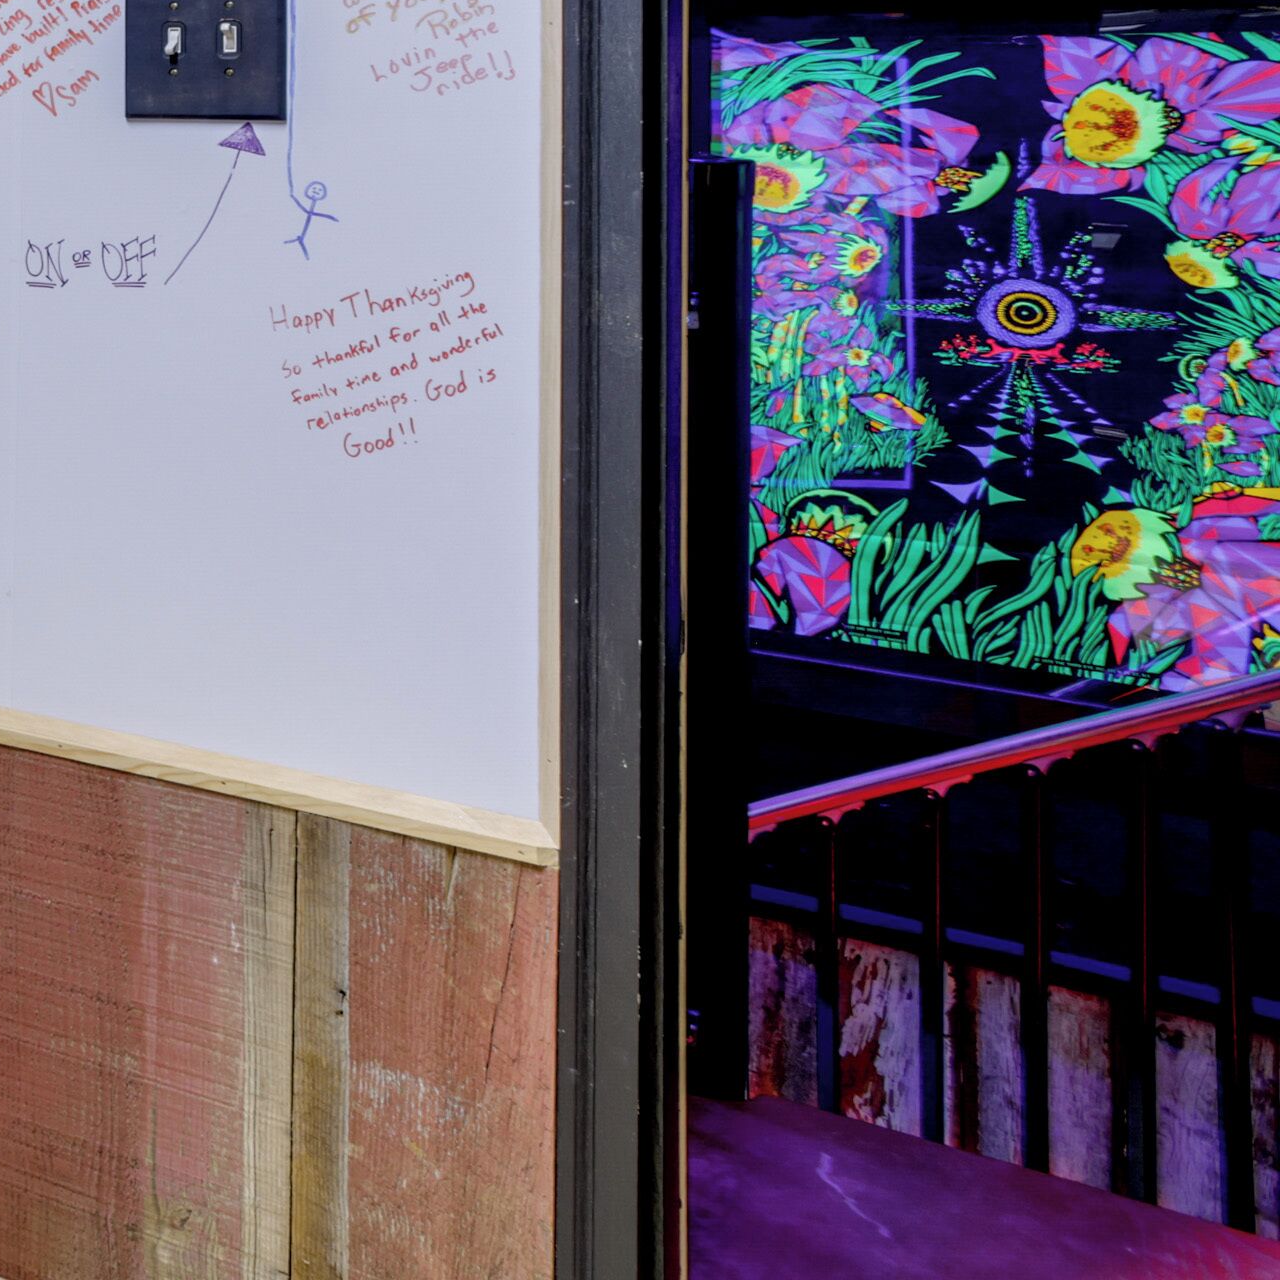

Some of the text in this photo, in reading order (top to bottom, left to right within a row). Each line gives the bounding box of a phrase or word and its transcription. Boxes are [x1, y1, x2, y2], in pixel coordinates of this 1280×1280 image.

[43, 27, 95, 62] family
[87, 3, 123, 34] time
[55, 69, 101, 108] Sam
[25, 233, 157, 289] ON OR OFF
[268, 270, 476, 335] Happy Thanksgiving
[290, 322, 505, 405] family time and wonderful
[311, 334, 382, 369] thankful
[388, 326, 421, 344] for
[428, 309, 451, 334] all
[457, 301, 489, 322] the
[424, 369, 469, 402] God
[477, 367, 499, 384] is
